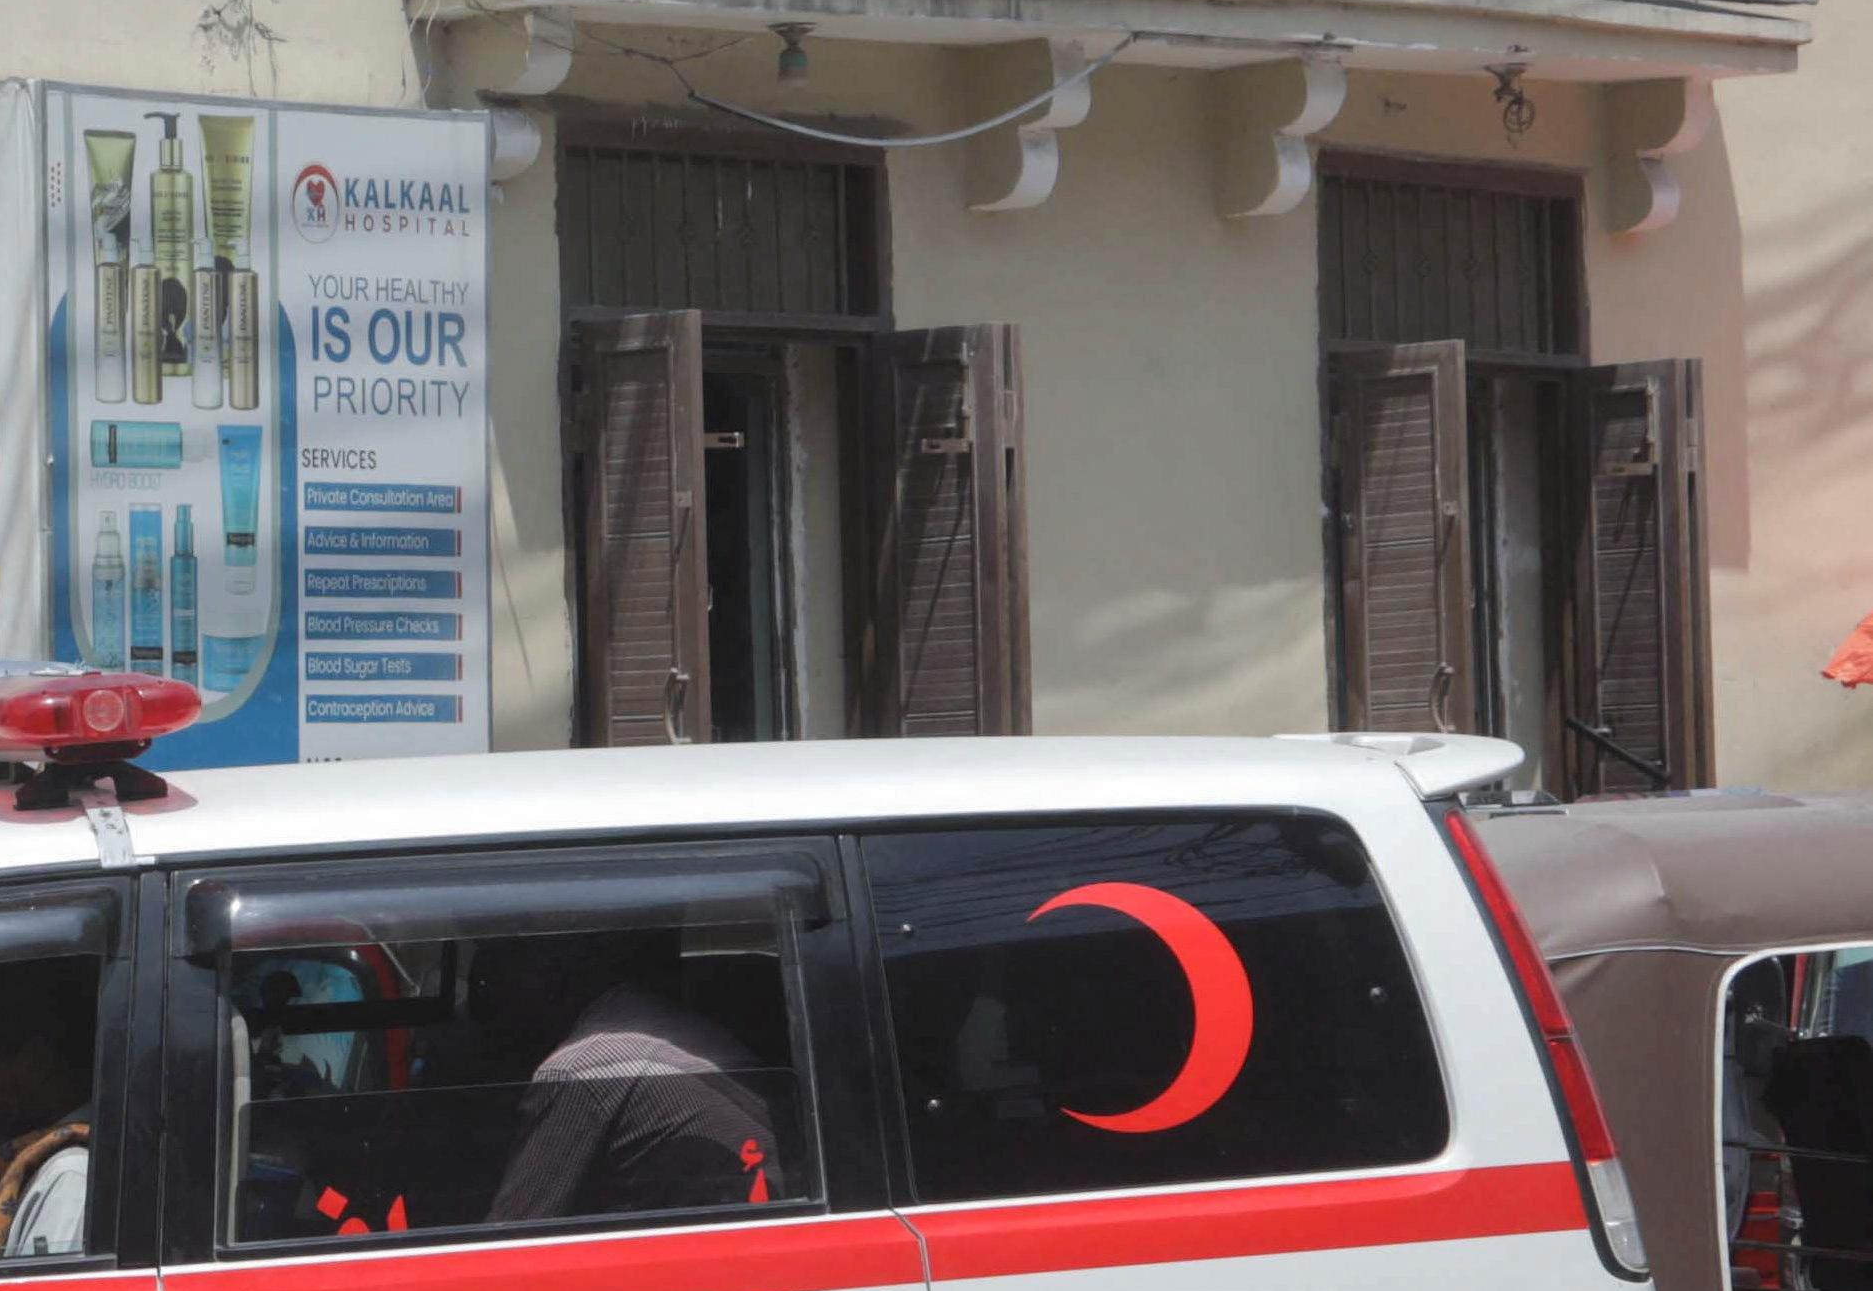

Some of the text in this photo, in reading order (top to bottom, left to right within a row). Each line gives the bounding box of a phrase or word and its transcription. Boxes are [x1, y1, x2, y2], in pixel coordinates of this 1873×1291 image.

[344, 177, 471, 214] KALKAAL
[344, 213, 471, 237] HOSPITAL
[308, 273, 470, 307] YOUR HEALTHY
[311, 305, 468, 368] IS OUR
[313, 375, 471, 419] PRIORITY
[301, 448, 377, 470] SERVICES
[307, 487, 454, 507] Private Consultation Area
[307, 531, 429, 550] Advice & Information
[307, 573, 427, 598] Repeat Prescriptions
[307, 616, 440, 634] Blood Pressure Checks
[307, 657, 412, 679] Blood Sugar Tests
[307, 700, 436, 721] Contraception Advice
